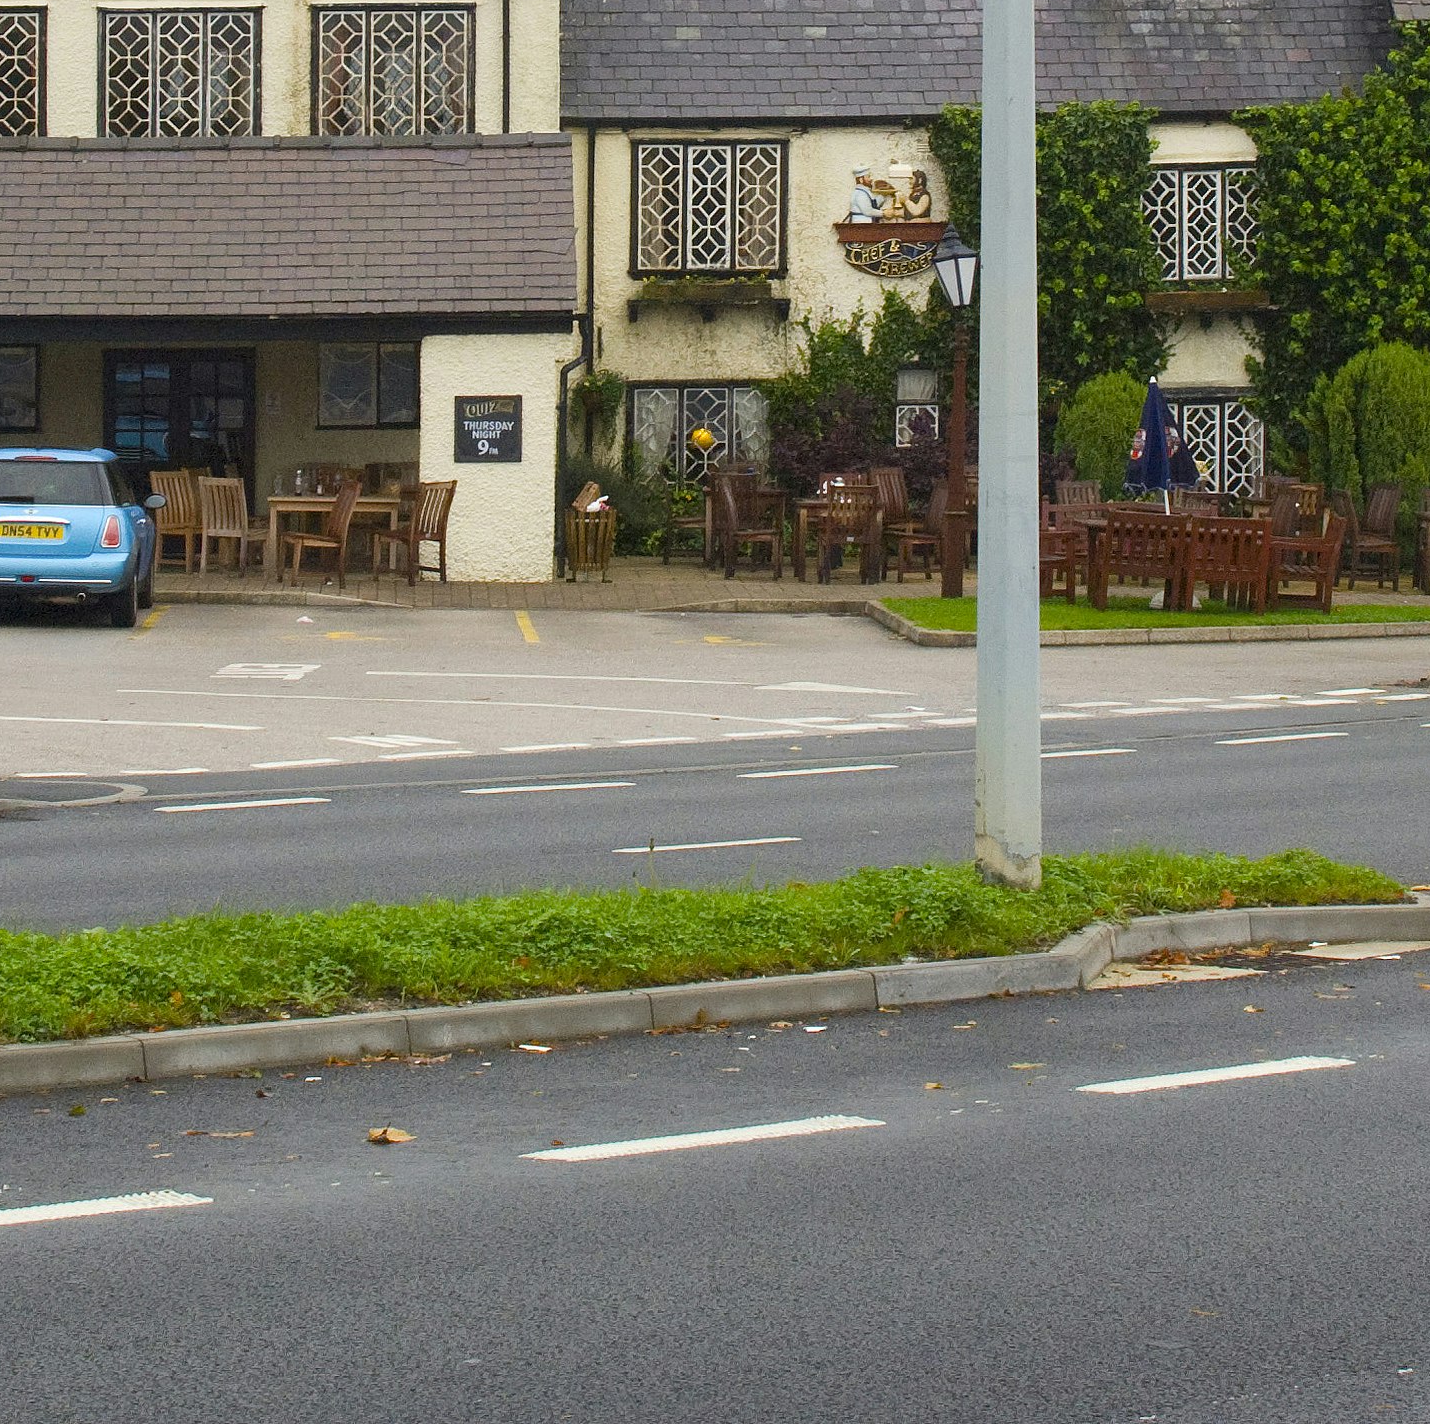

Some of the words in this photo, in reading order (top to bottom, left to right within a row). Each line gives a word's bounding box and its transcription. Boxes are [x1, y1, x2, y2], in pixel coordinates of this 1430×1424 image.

[850, 243, 886, 264] CHEF
[889, 239, 901, 252] &
[466, 401, 497, 417] QUIZ
[463, 421, 515, 431] THURSDAY
[472, 430, 502, 439] NIGHT
[2, 525, 32, 536] DN54
[35, 526, 59, 538] TVY
